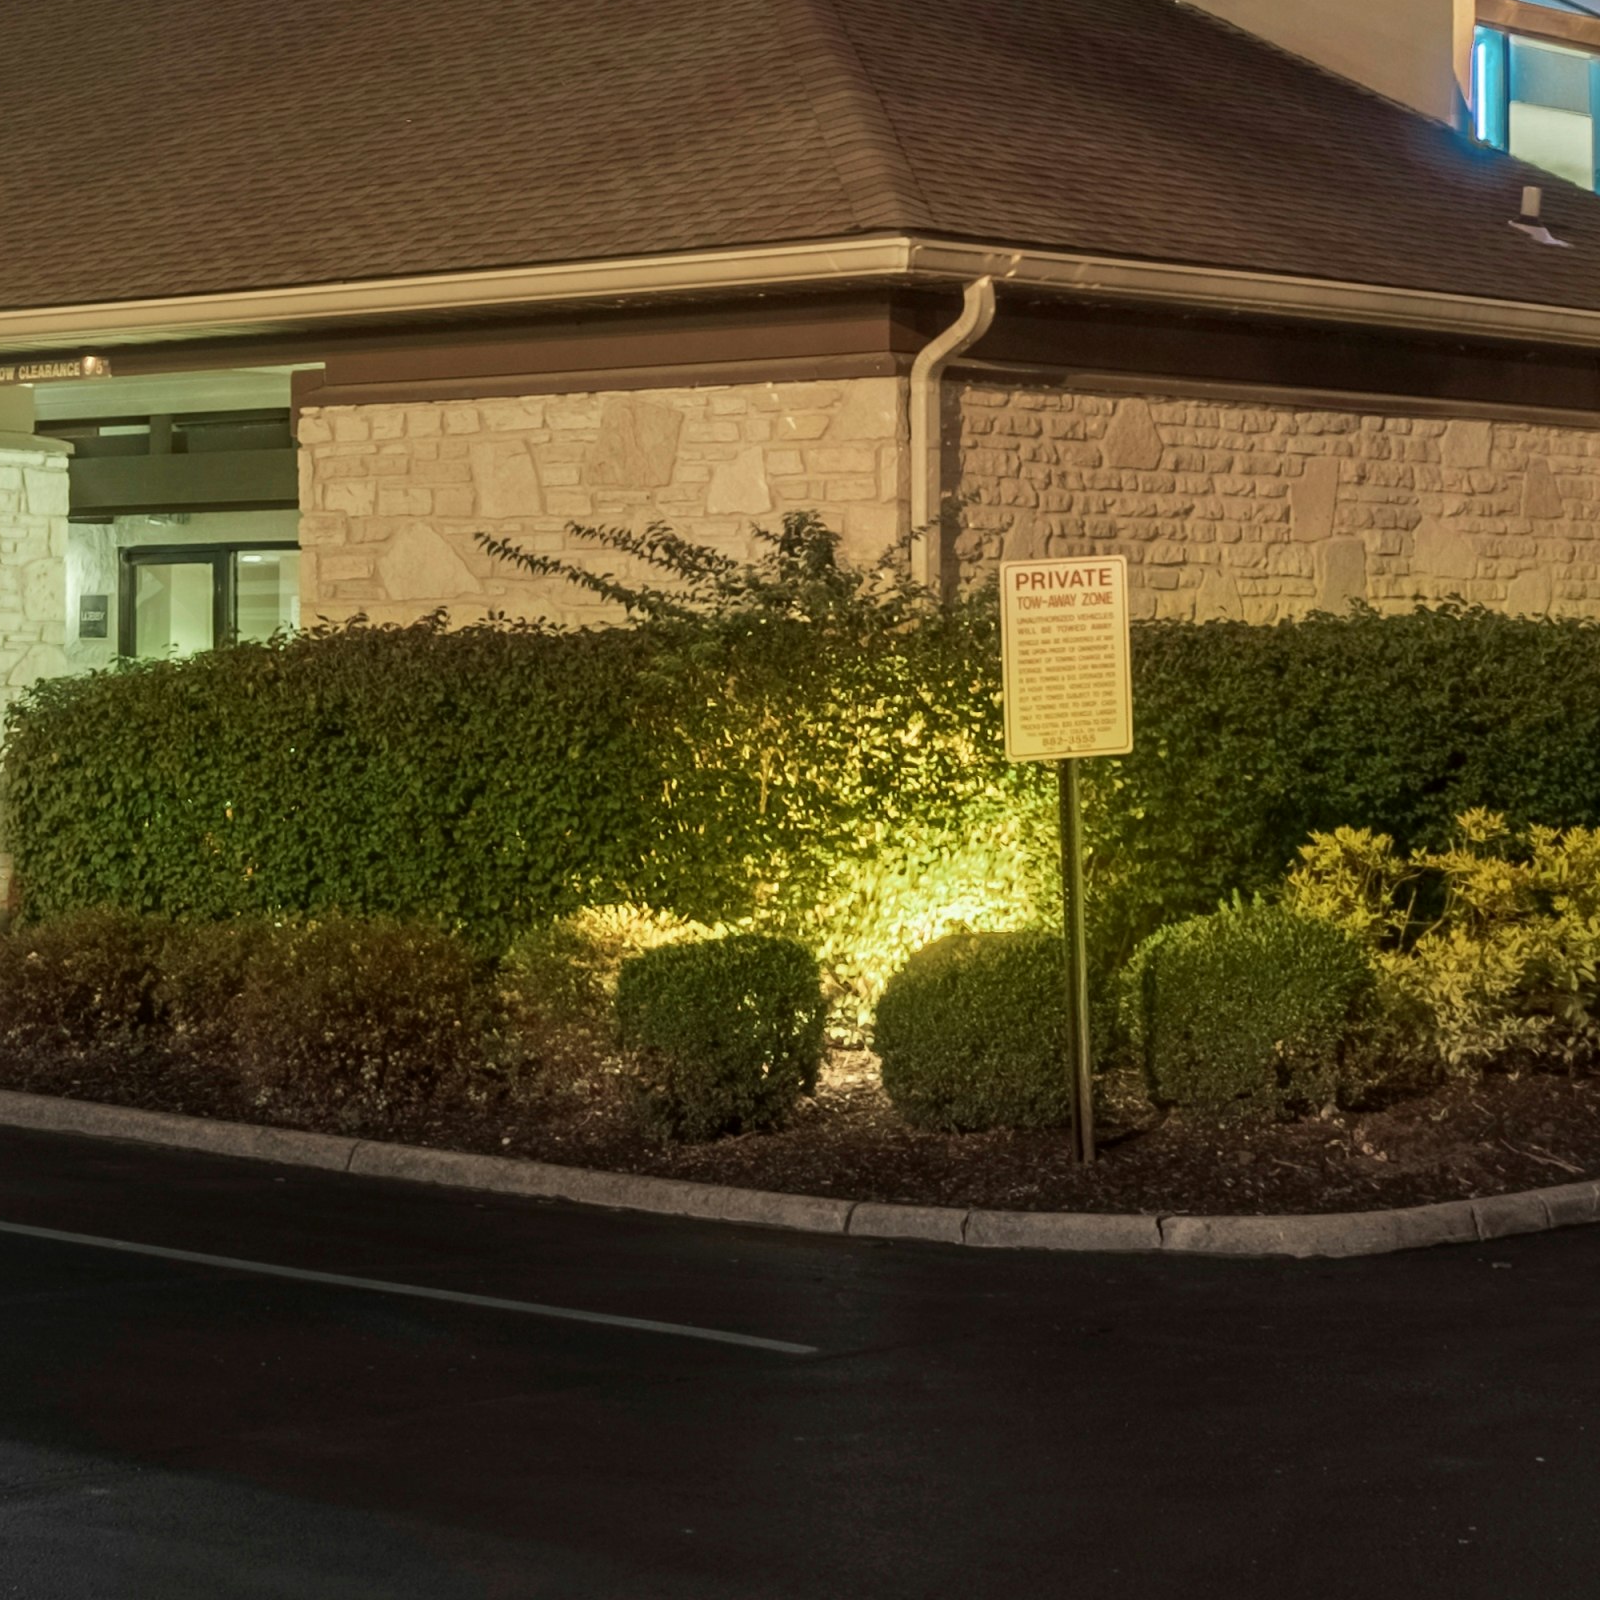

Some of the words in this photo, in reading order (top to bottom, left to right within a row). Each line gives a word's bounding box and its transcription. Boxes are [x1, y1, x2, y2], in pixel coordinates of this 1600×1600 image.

[18, 361, 80, 380] CLEARANCE
[1015, 568, 1113, 591] PRIVATE
[1016, 593, 1077, 610] TOW-AWAY
[1081, 591, 1114, 606] ZONE
[1016, 614, 1075, 625] UNAUTHORIZED
[1077, 612, 1114, 621] VEHICLES
[1017, 627, 1036, 635] WILL
[1041, 626, 1052, 634] BE
[1057, 624, 1086, 632] TOWED
